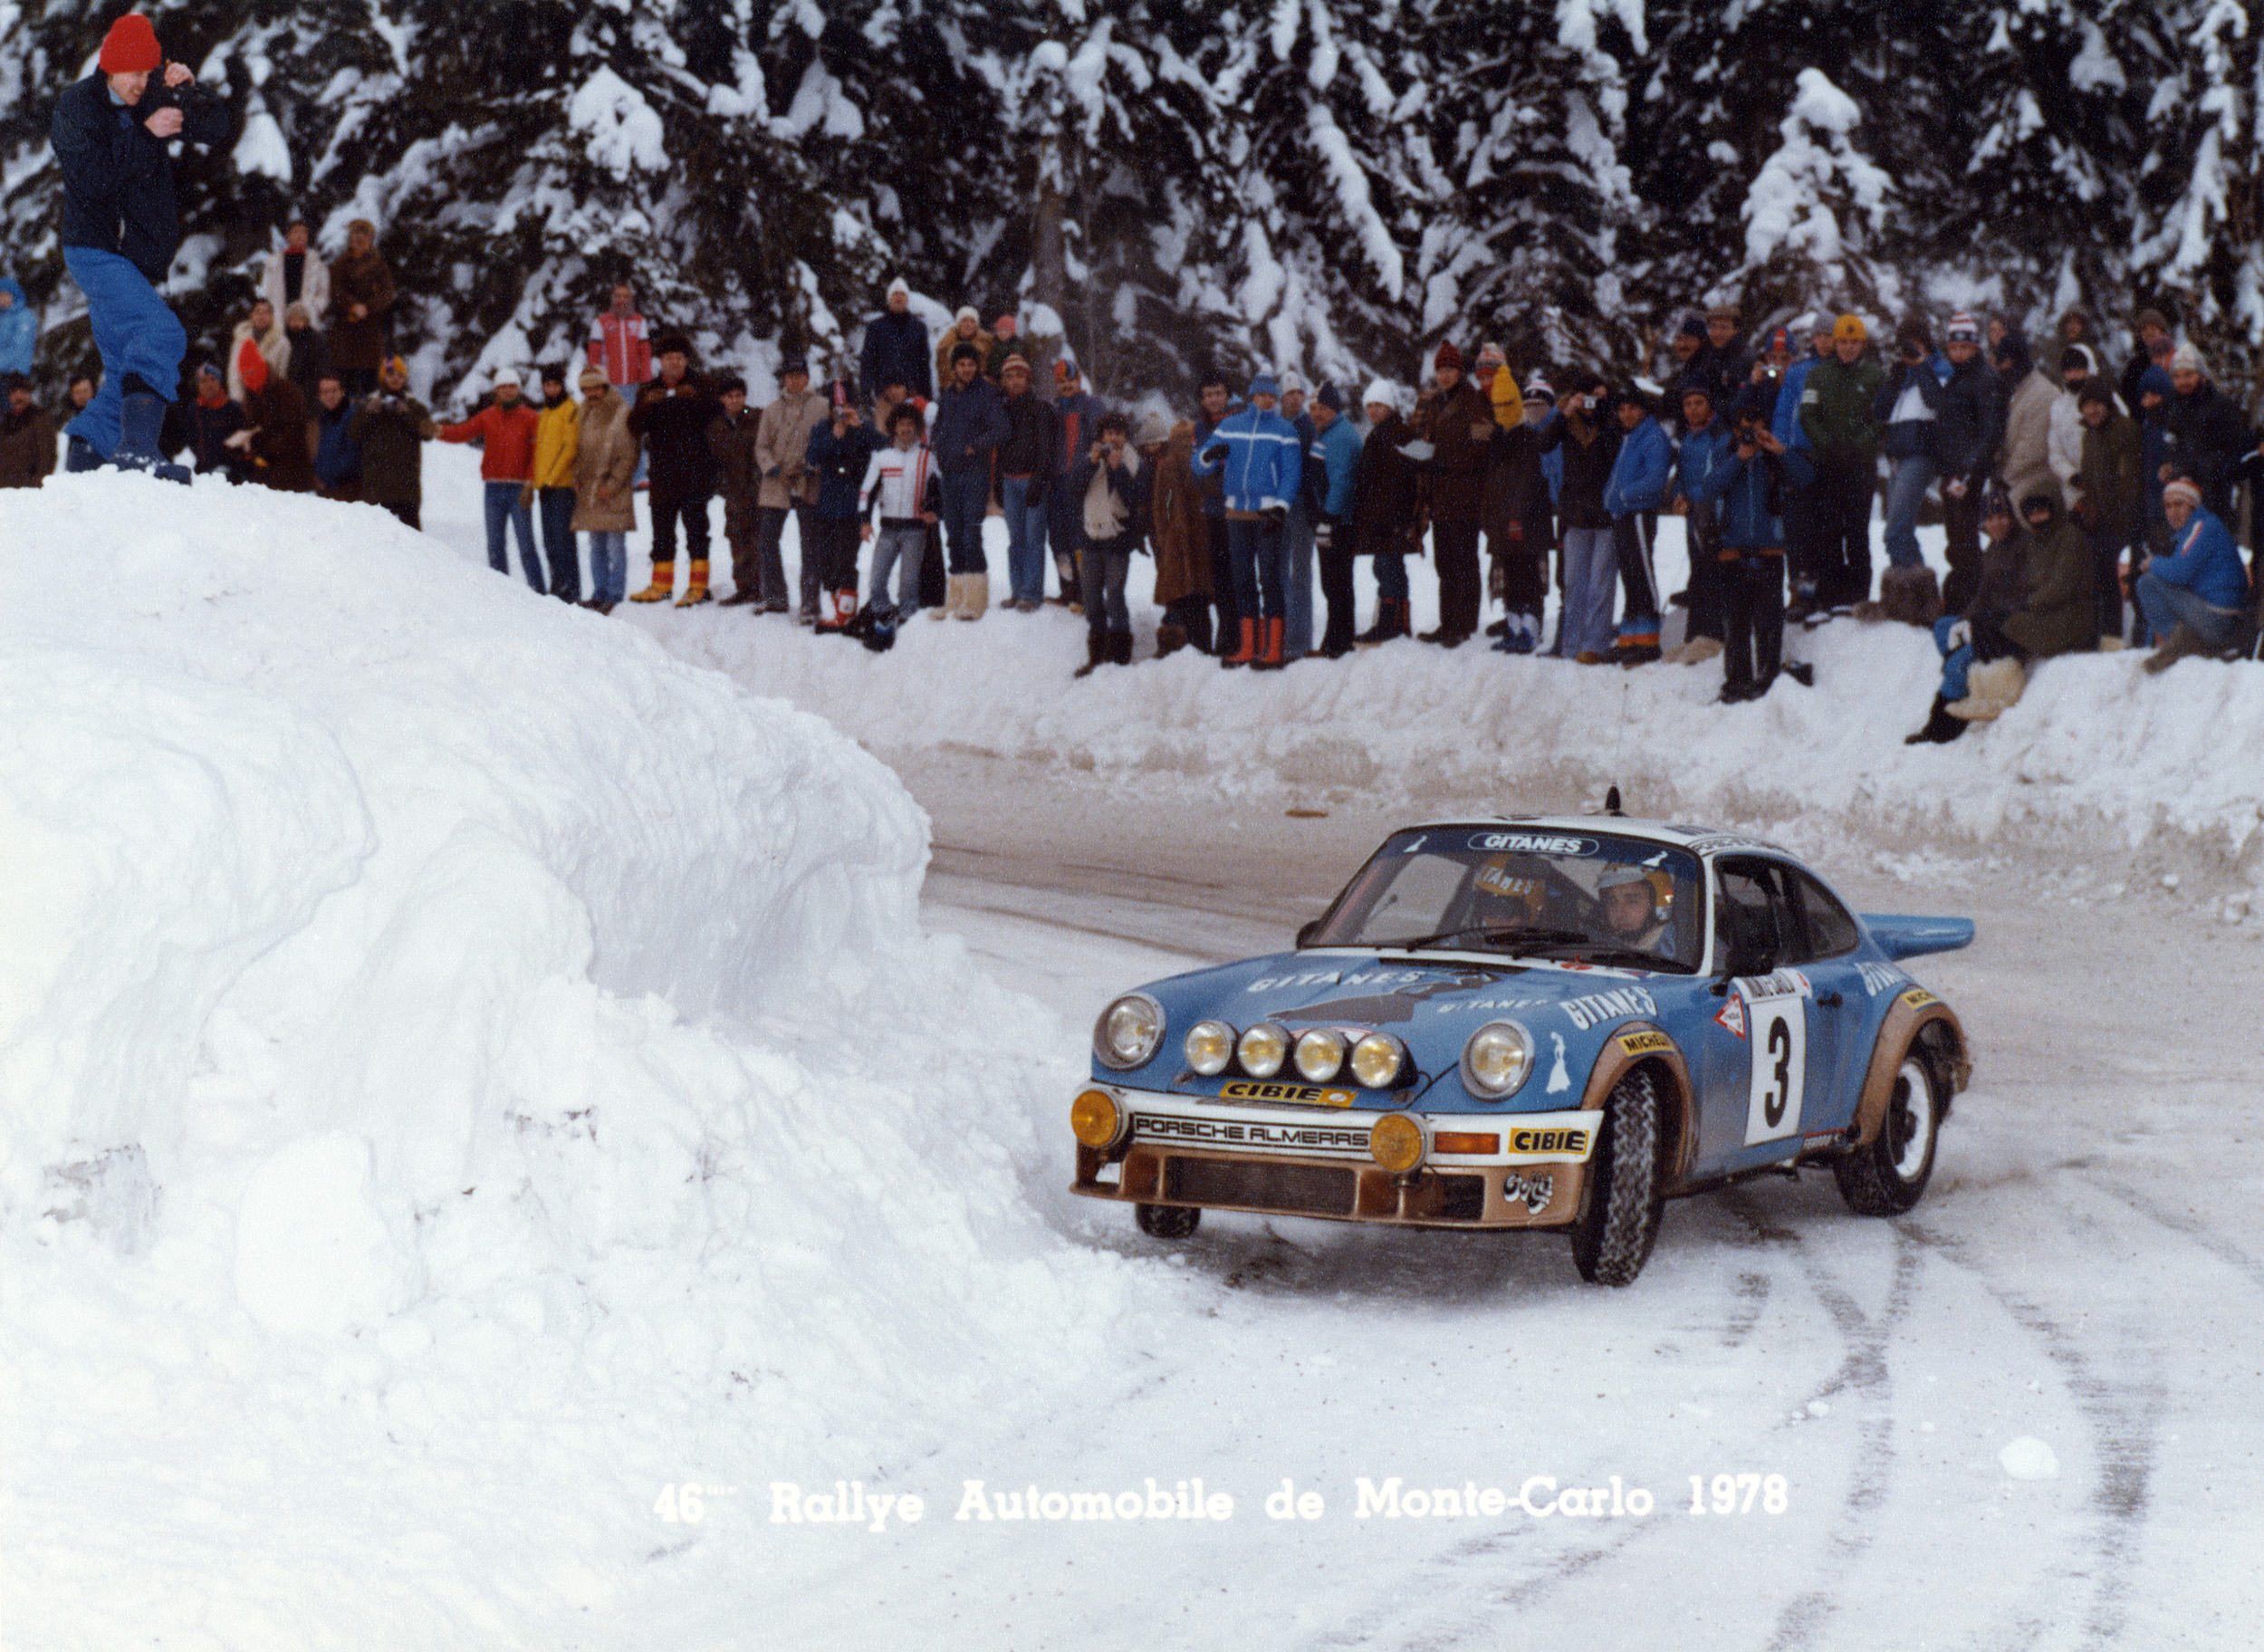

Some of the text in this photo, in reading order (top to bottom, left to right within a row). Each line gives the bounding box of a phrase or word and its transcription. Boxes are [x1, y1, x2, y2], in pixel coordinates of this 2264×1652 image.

[1484, 835, 1582, 853] GITANES
[1247, 971, 1426, 993] GITANES
[1559, 985, 1658, 1031] GITANES
[1765, 1016, 1790, 1129] 3
[1227, 1083, 1324, 1101] CIBIE
[1136, 1118, 1369, 1147] PORSCHE ALMERAS
[1514, 1130, 1587, 1151] CIBIE
